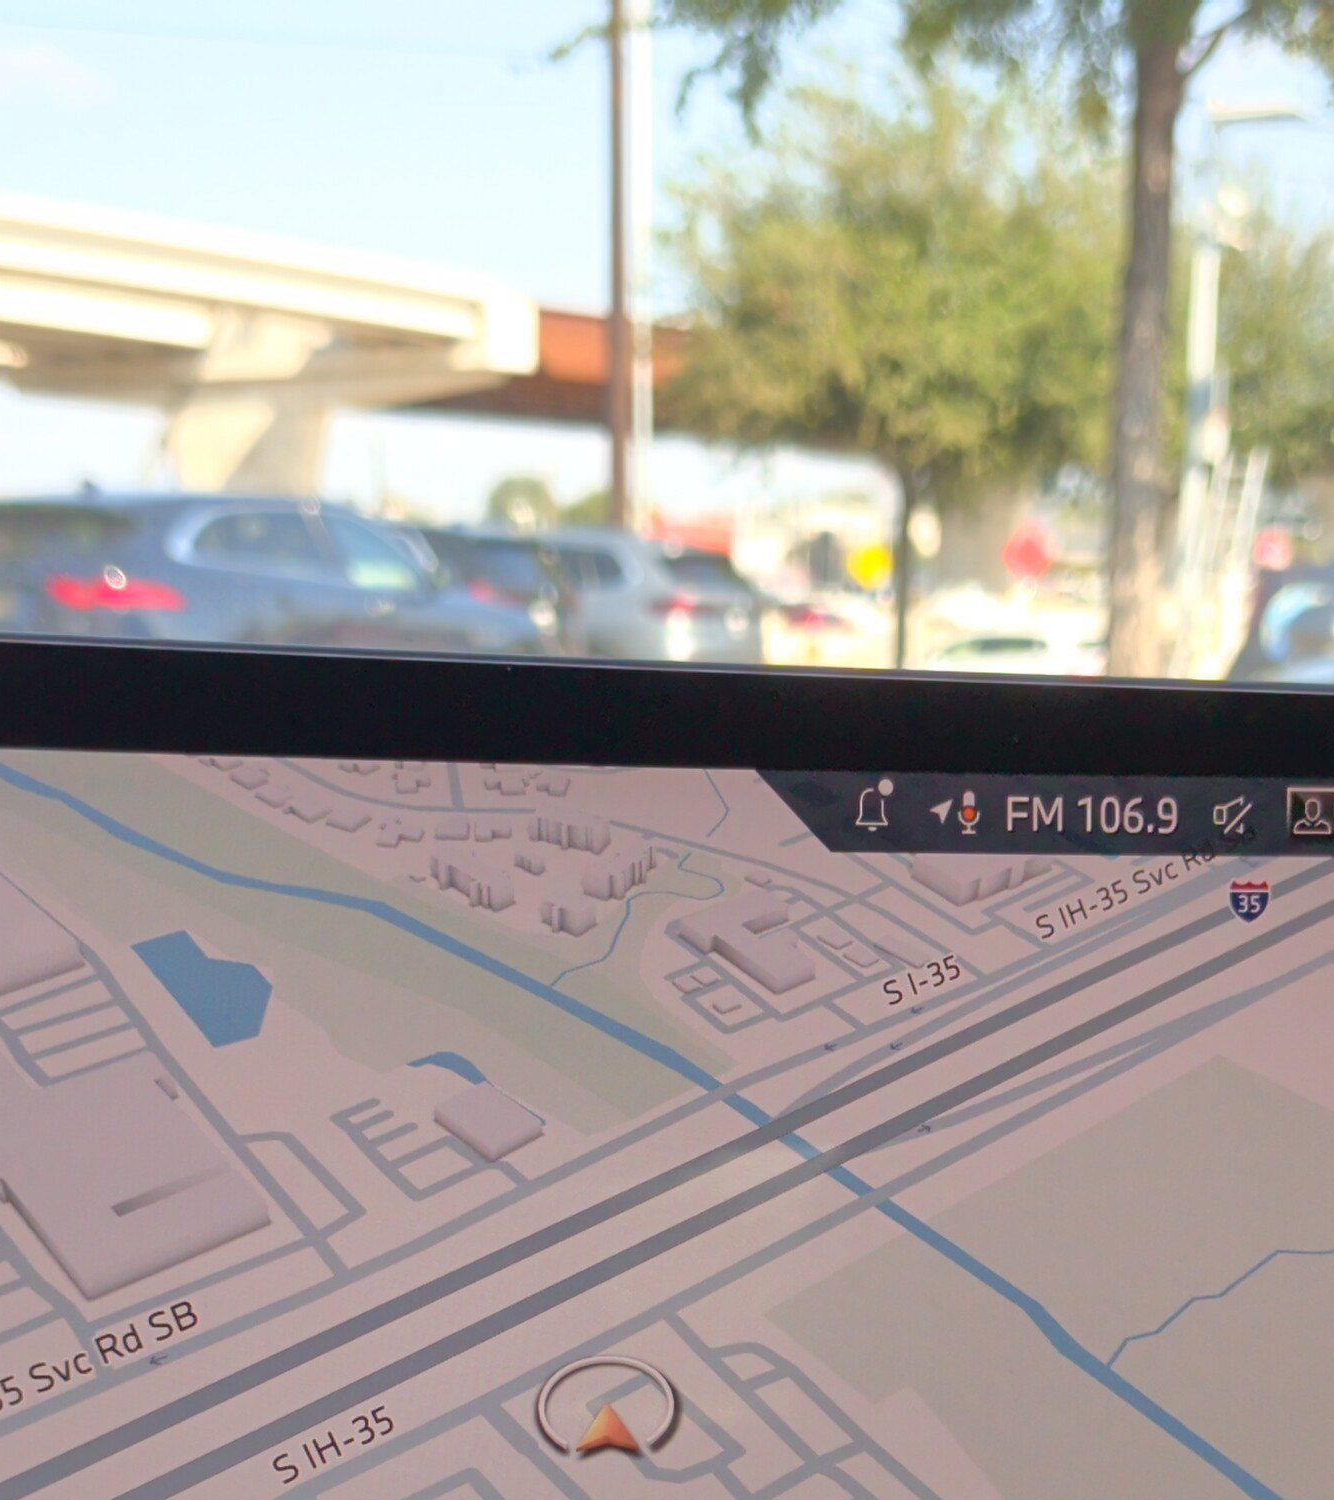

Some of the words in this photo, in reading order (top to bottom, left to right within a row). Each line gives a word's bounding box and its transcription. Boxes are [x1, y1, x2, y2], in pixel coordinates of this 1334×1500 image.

[1005, 795, 1064, 833] FM
[1077, 795, 1179, 835] 106.9
[1035, 914, 1055, 940] S
[1058, 880, 1129, 929] IH-35
[1131, 862, 1179, 895] Svc
[1236, 894, 1261, 914] 35
[882, 979, 904, 1006] S
[906, 954, 962, 996] I-35
[28, 1352, 94, 1393] Svc
[94, 1322, 144, 1365] Rd
[147, 1300, 199, 1342] SB
[272, 1452, 300, 1485] S
[301, 1404, 395, 1470] IH-35
